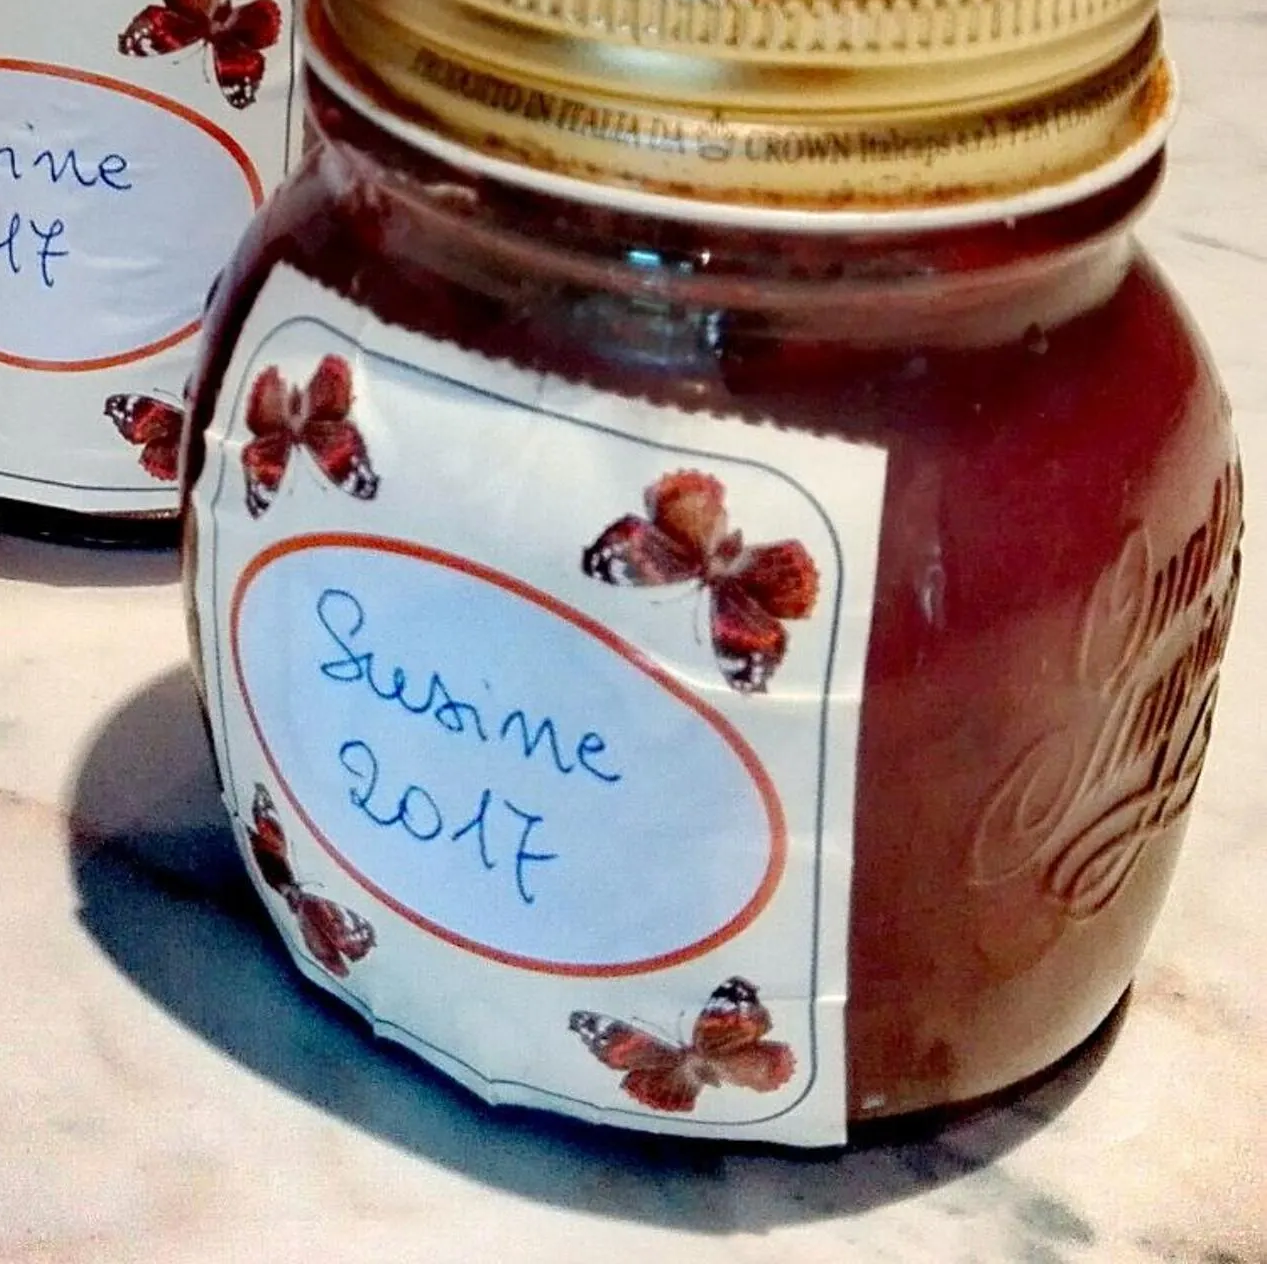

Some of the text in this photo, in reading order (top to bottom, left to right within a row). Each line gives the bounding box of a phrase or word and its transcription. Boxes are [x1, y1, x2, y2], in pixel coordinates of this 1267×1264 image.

[744, 129, 851, 164] CROWN
[316, 588, 622, 783] Susine
[338, 740, 558, 904] 2017
